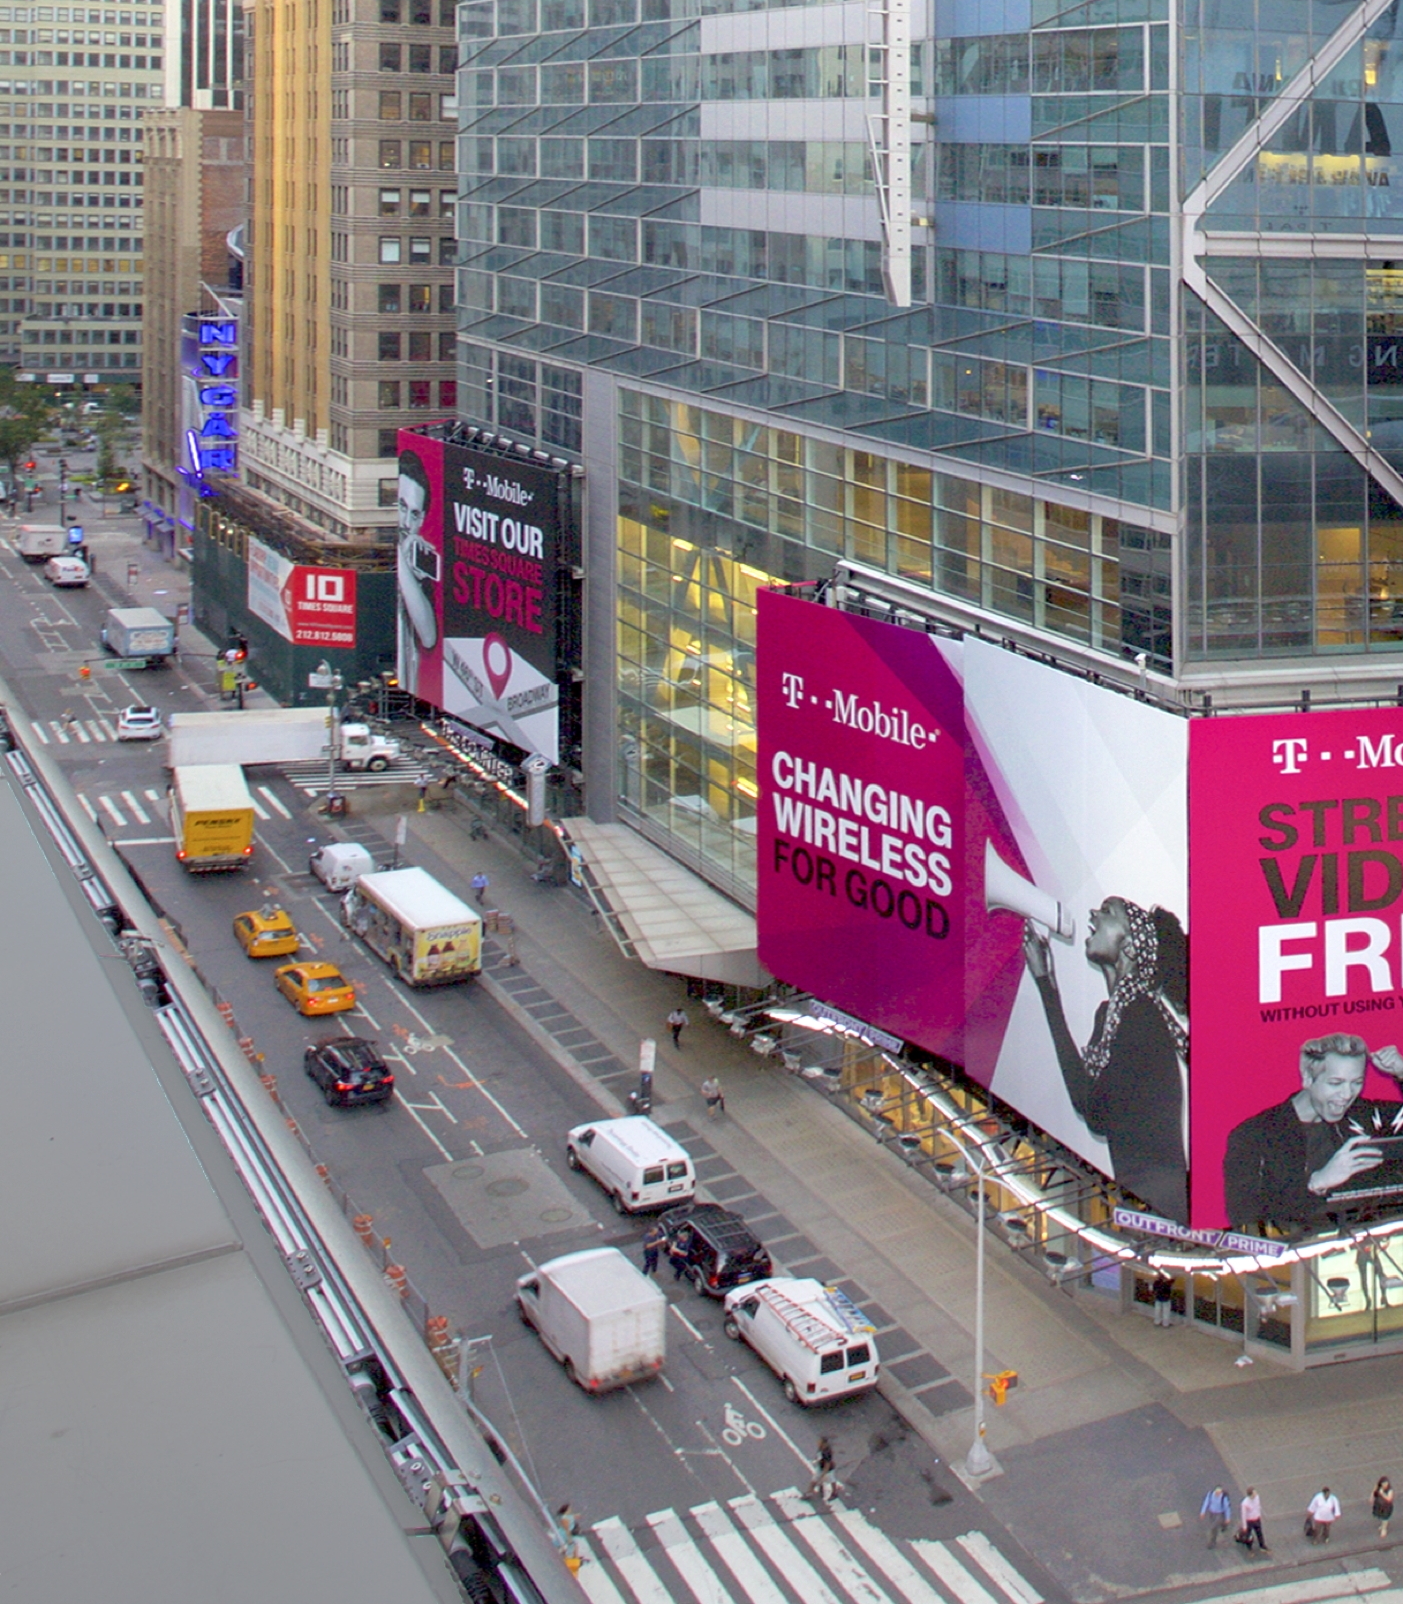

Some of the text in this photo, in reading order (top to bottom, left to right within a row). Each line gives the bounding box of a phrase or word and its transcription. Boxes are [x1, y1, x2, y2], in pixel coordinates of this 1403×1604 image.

[454, 501, 543, 559] VISIT OUR
[454, 536, 543, 586] TIMES SQUARE
[297, 600, 322, 611] TIMES
[322, 602, 354, 614] SQUARE
[306, 574, 344, 602] 10
[453, 561, 543, 634] STORE
[507, 682, 551, 712] BROADWAY
[771, 750, 952, 849] CHANGING
[772, 791, 952, 897] WIRELESS
[773, 838, 950, 940] FOR GOOD
[1260, 1002, 1341, 1024] WITHOUT
[1343, 996, 1395, 1015] USING
[1227, 1236, 1280, 1256] PRIME
